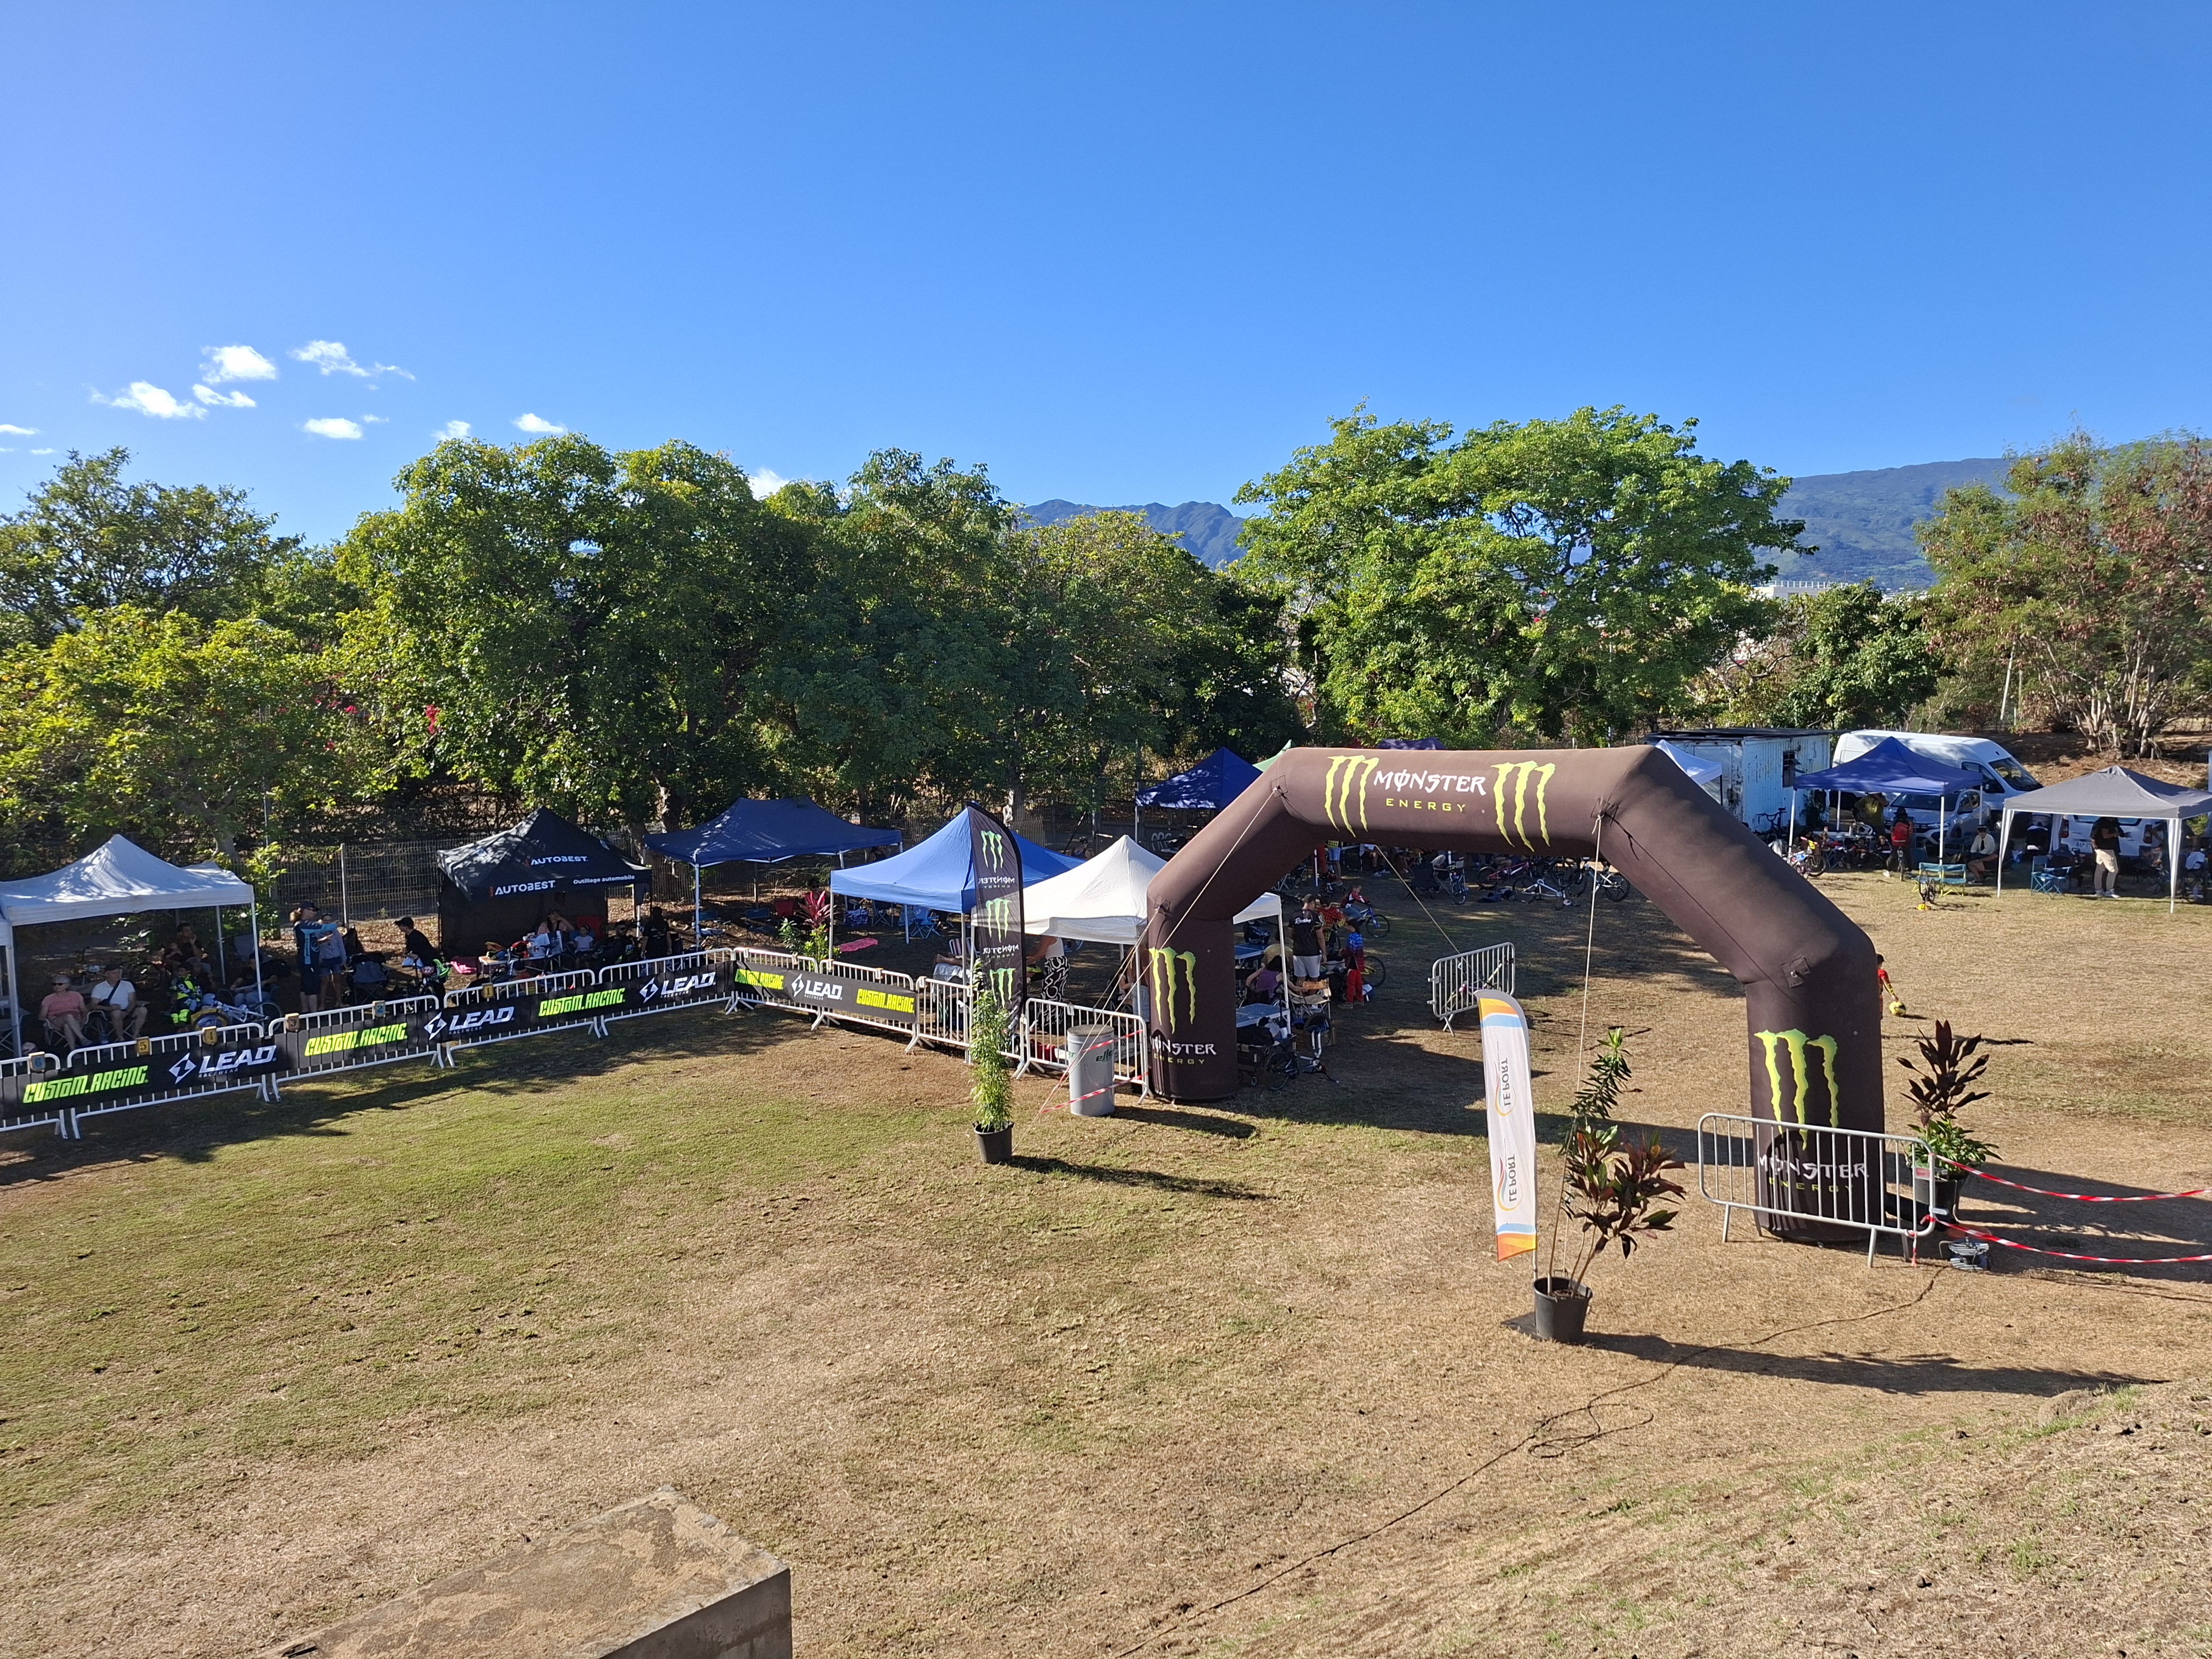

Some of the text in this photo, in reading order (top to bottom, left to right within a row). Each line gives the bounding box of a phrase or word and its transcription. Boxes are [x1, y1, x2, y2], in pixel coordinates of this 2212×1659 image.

[1386, 798, 1466, 812] ENERGY
[530, 856, 588, 866] AUTOBEST
[573, 876, 601, 885] Outillage
[494, 880, 556, 896] AUTOBEST
[661, 972, 716, 995] LEAD
[486, 987, 491, 995] 1
[805, 979, 843, 1000] LEAD
[377, 1004, 383, 1013] 2
[290, 1019, 296, 1027] 3
[449, 1006, 515, 1031] LEAD
[448, 1026, 483, 1035] RACEWEAR
[140, 1042, 147, 1051] 5
[35, 1058, 41, 1067] 6
[199, 1045, 276, 1073] LEAD
[198, 1068, 238, 1078] RACEWEAR
